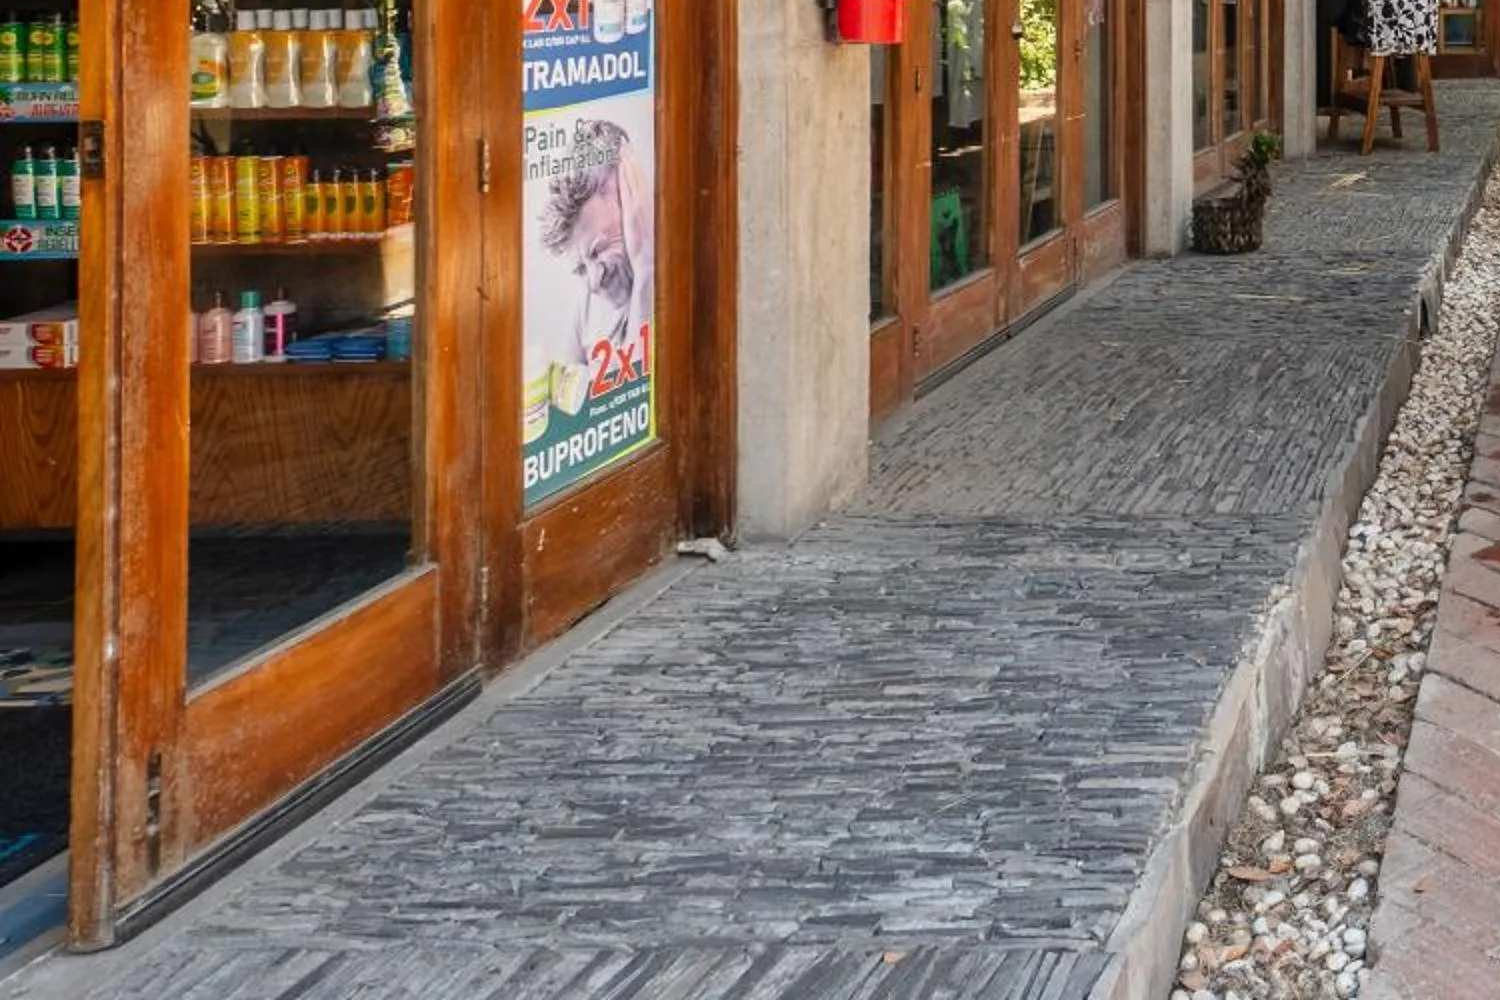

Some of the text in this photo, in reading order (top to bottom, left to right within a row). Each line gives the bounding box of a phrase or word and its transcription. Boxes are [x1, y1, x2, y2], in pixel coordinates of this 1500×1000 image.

[523, 51, 647, 93] TRAMADOL
[525, 117, 592, 154] Pain &
[590, 321, 652, 398] 2x1
[524, 401, 650, 489] BUPROFENO
